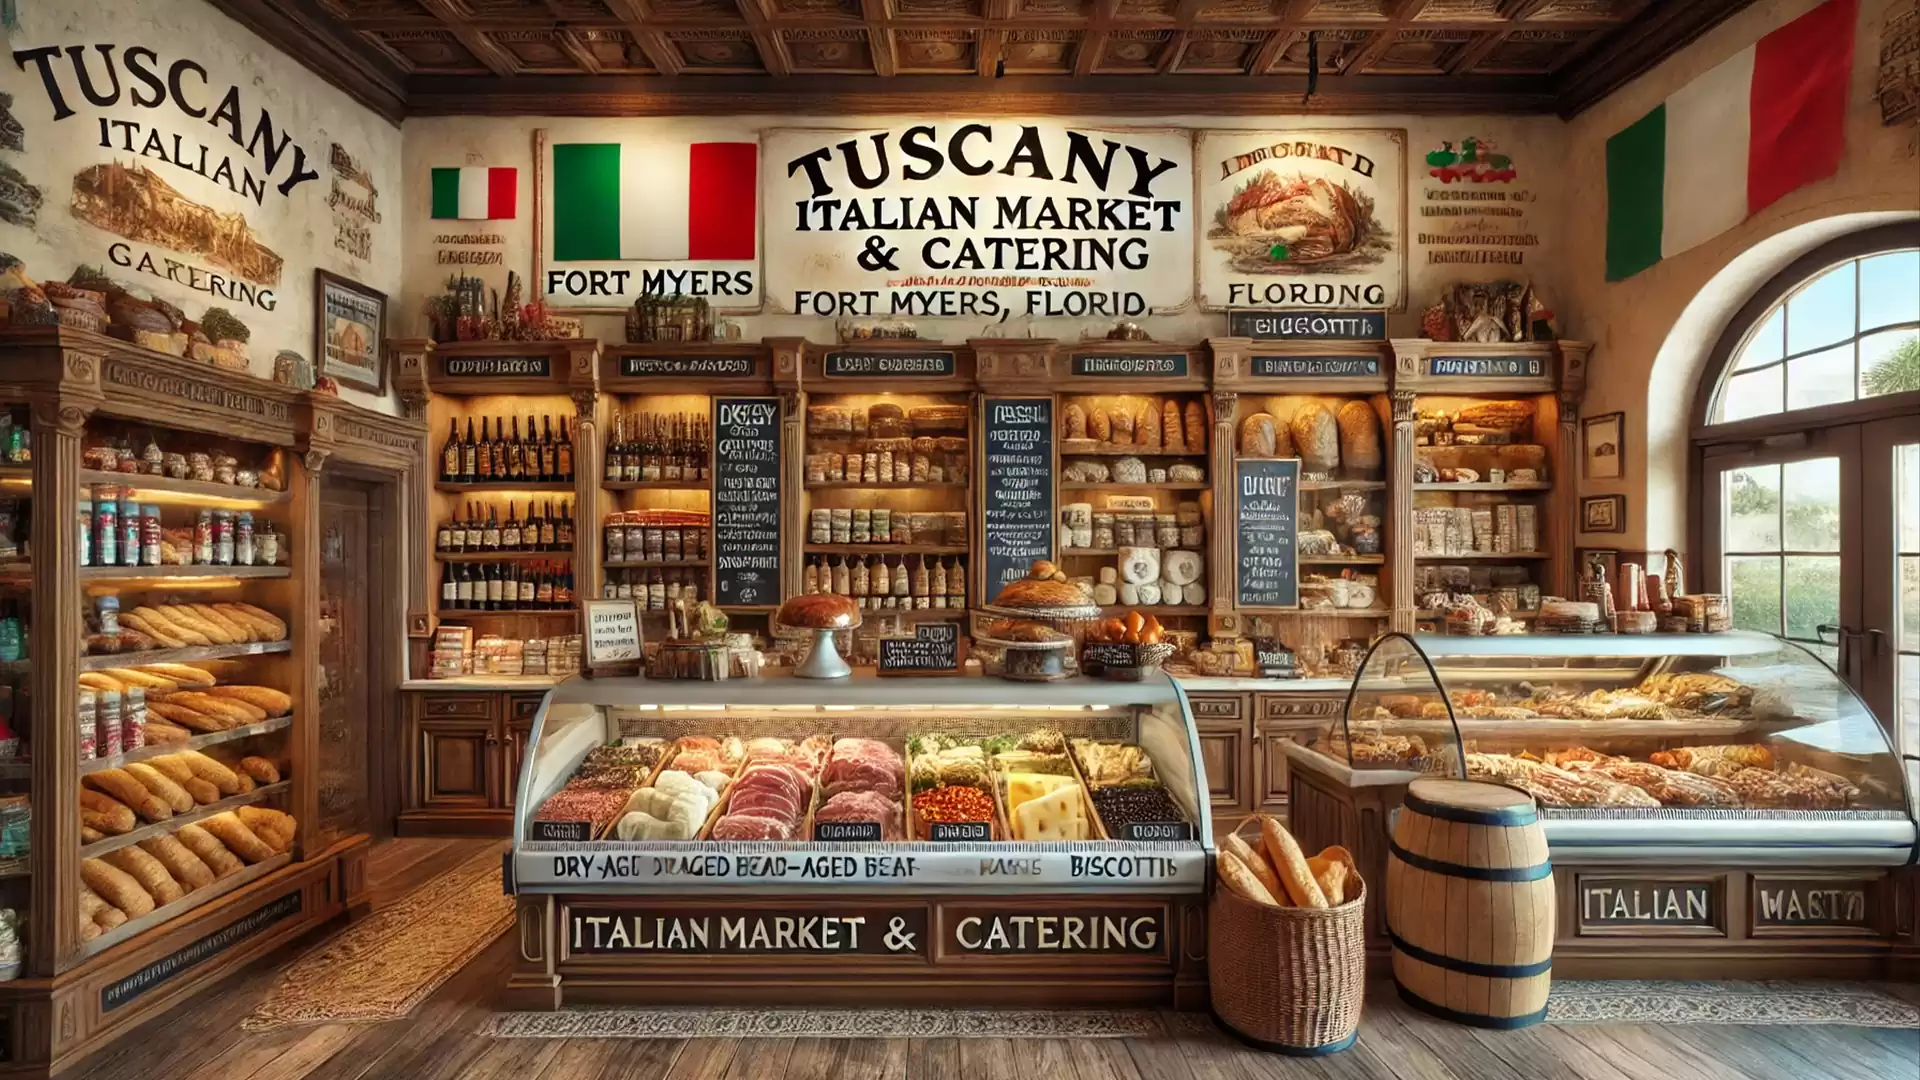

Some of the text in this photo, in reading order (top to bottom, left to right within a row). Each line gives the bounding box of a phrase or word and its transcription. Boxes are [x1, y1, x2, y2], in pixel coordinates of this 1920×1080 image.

[13, 44, 319, 197] TUSCANY
[99, 118, 267, 206] ITALIAN
[788, 124, 1178, 198] TUSCANY
[795, 196, 1180, 232] ITALIAN MARKET
[857, 235, 1149, 271] & CATERING
[548, 270, 754, 296] FORT MYERS
[795, 291, 879, 316] FORT
[891, 291, 1009, 322] MYERS,
[1584, 888, 1708, 920] ITALIAN
[574, 916, 1157, 951] ITALIAN MARKET & CATERING
